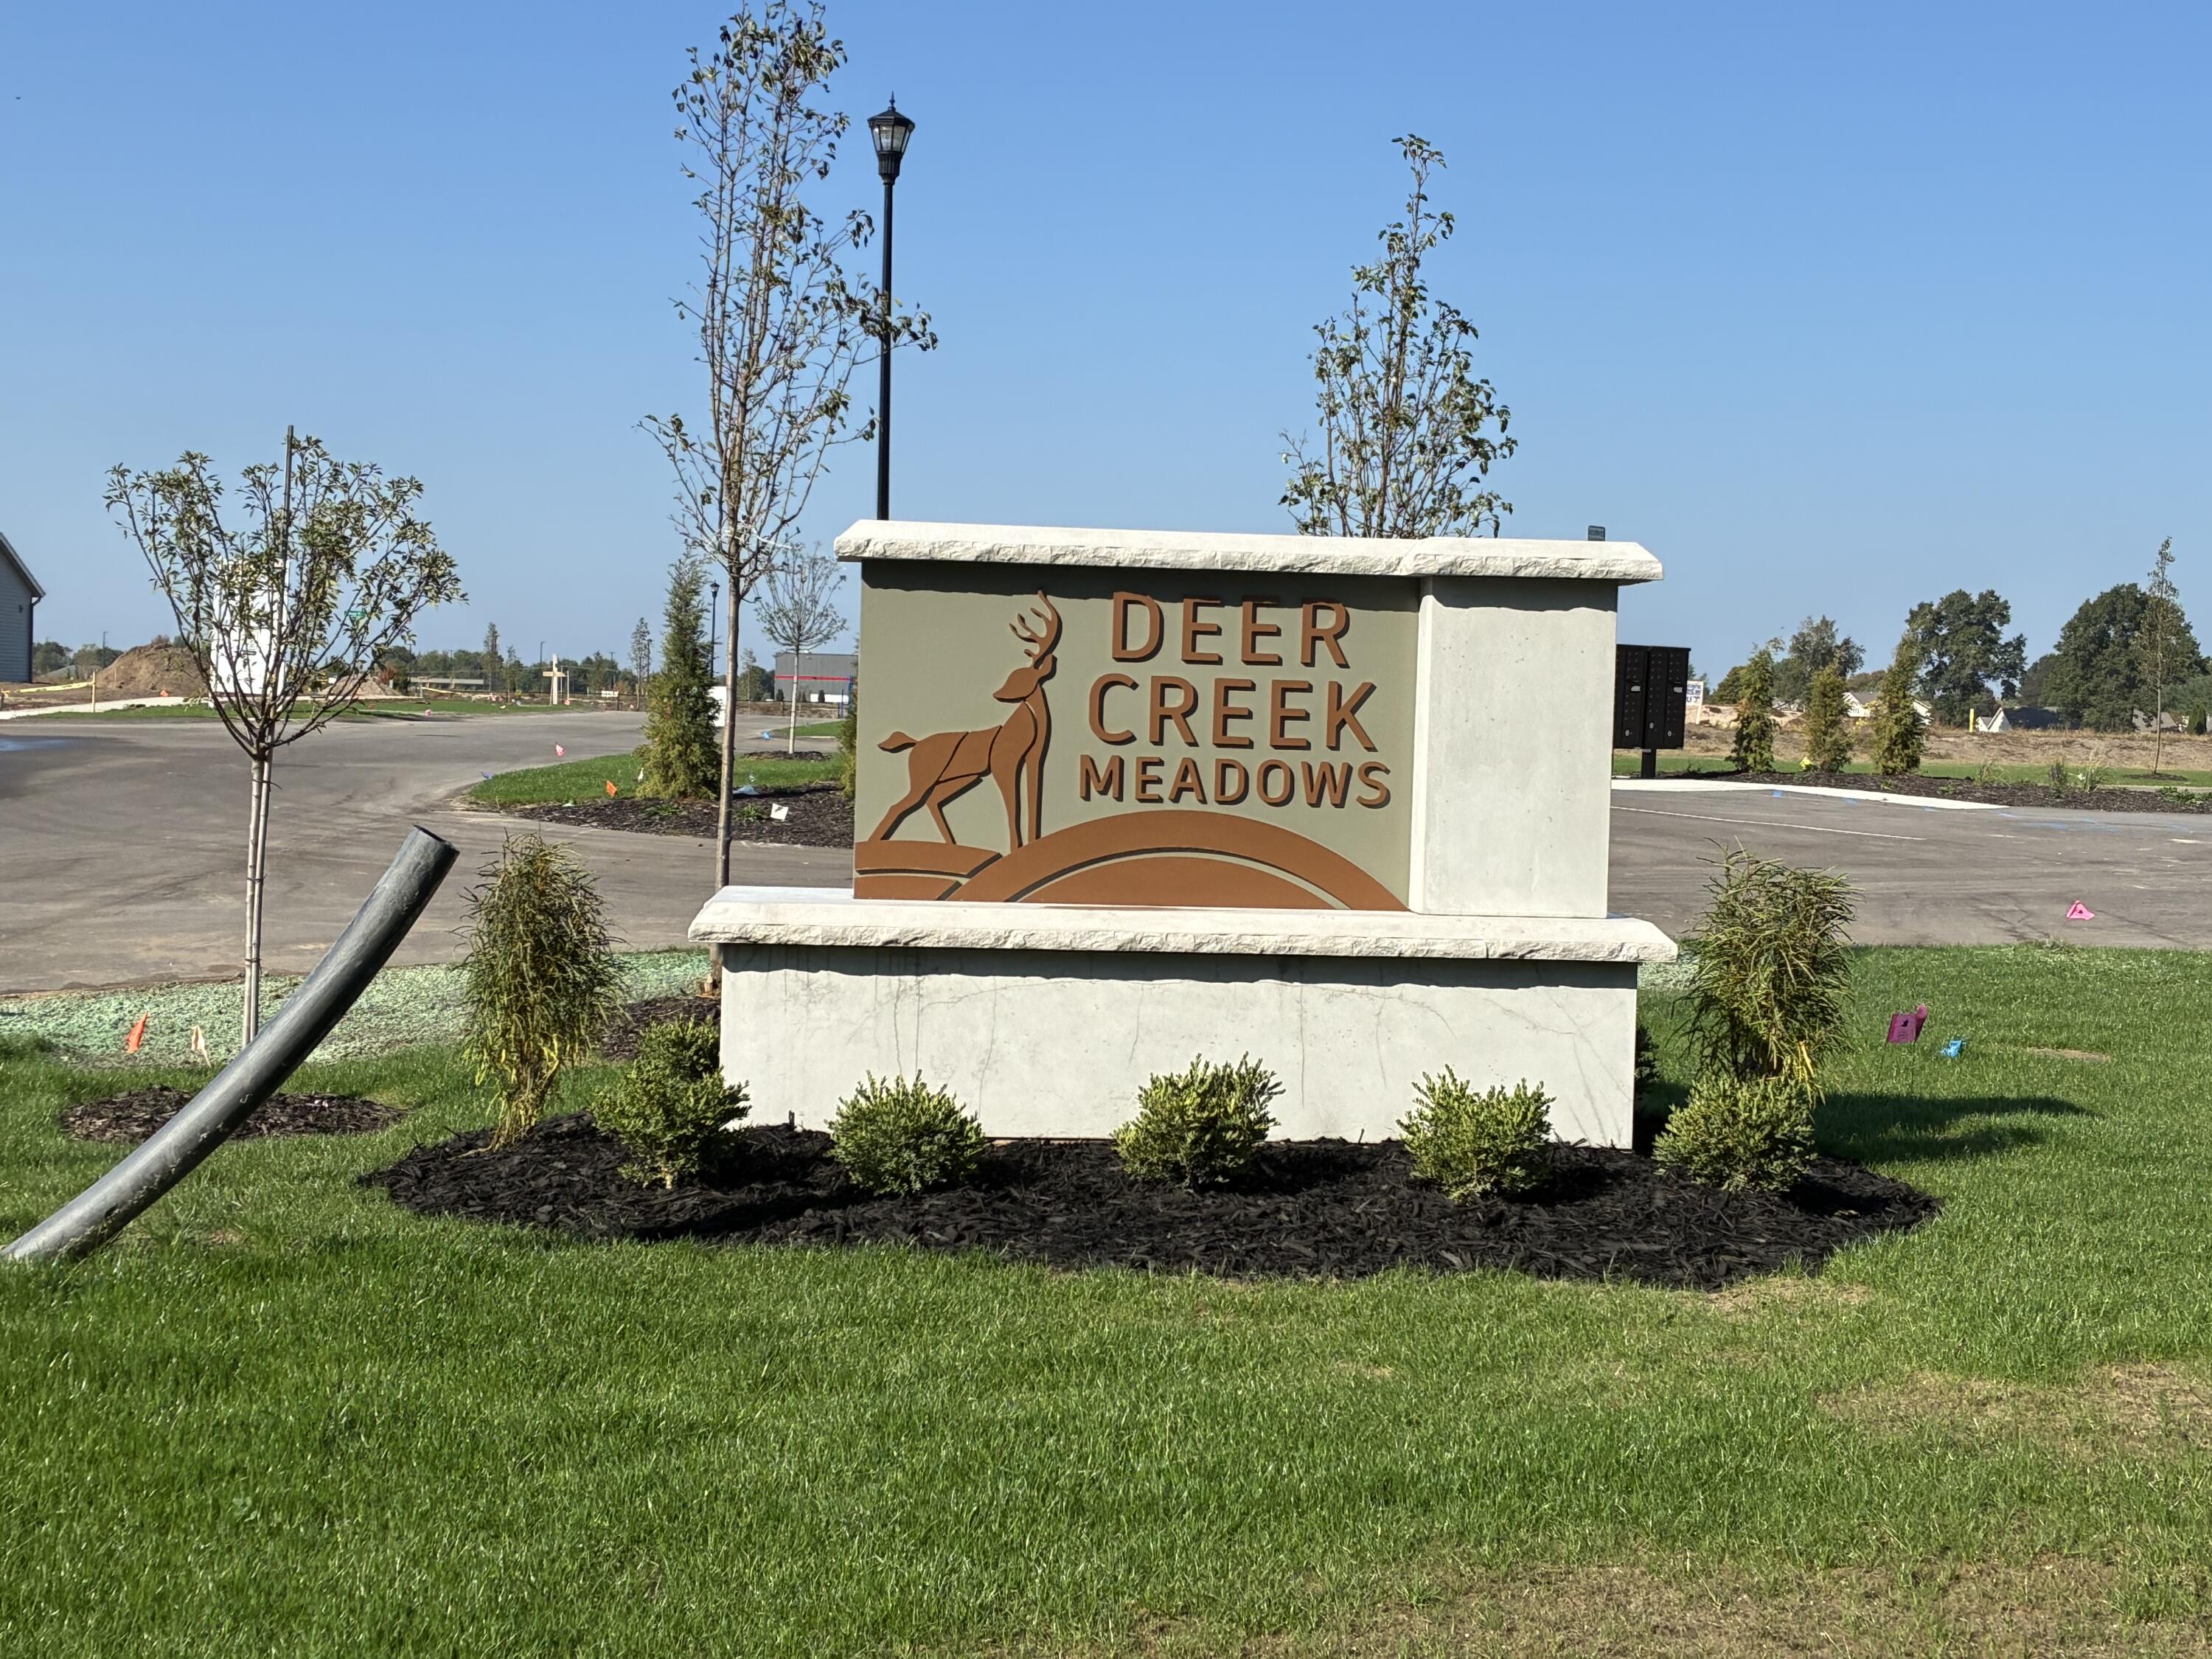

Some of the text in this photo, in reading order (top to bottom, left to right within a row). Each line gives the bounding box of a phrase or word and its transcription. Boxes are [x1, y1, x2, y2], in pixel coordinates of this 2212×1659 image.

[1111, 591, 1349, 668] DEER
[1088, 672, 1377, 752] CREEK
[1079, 754, 1391, 809] MEADOWS
